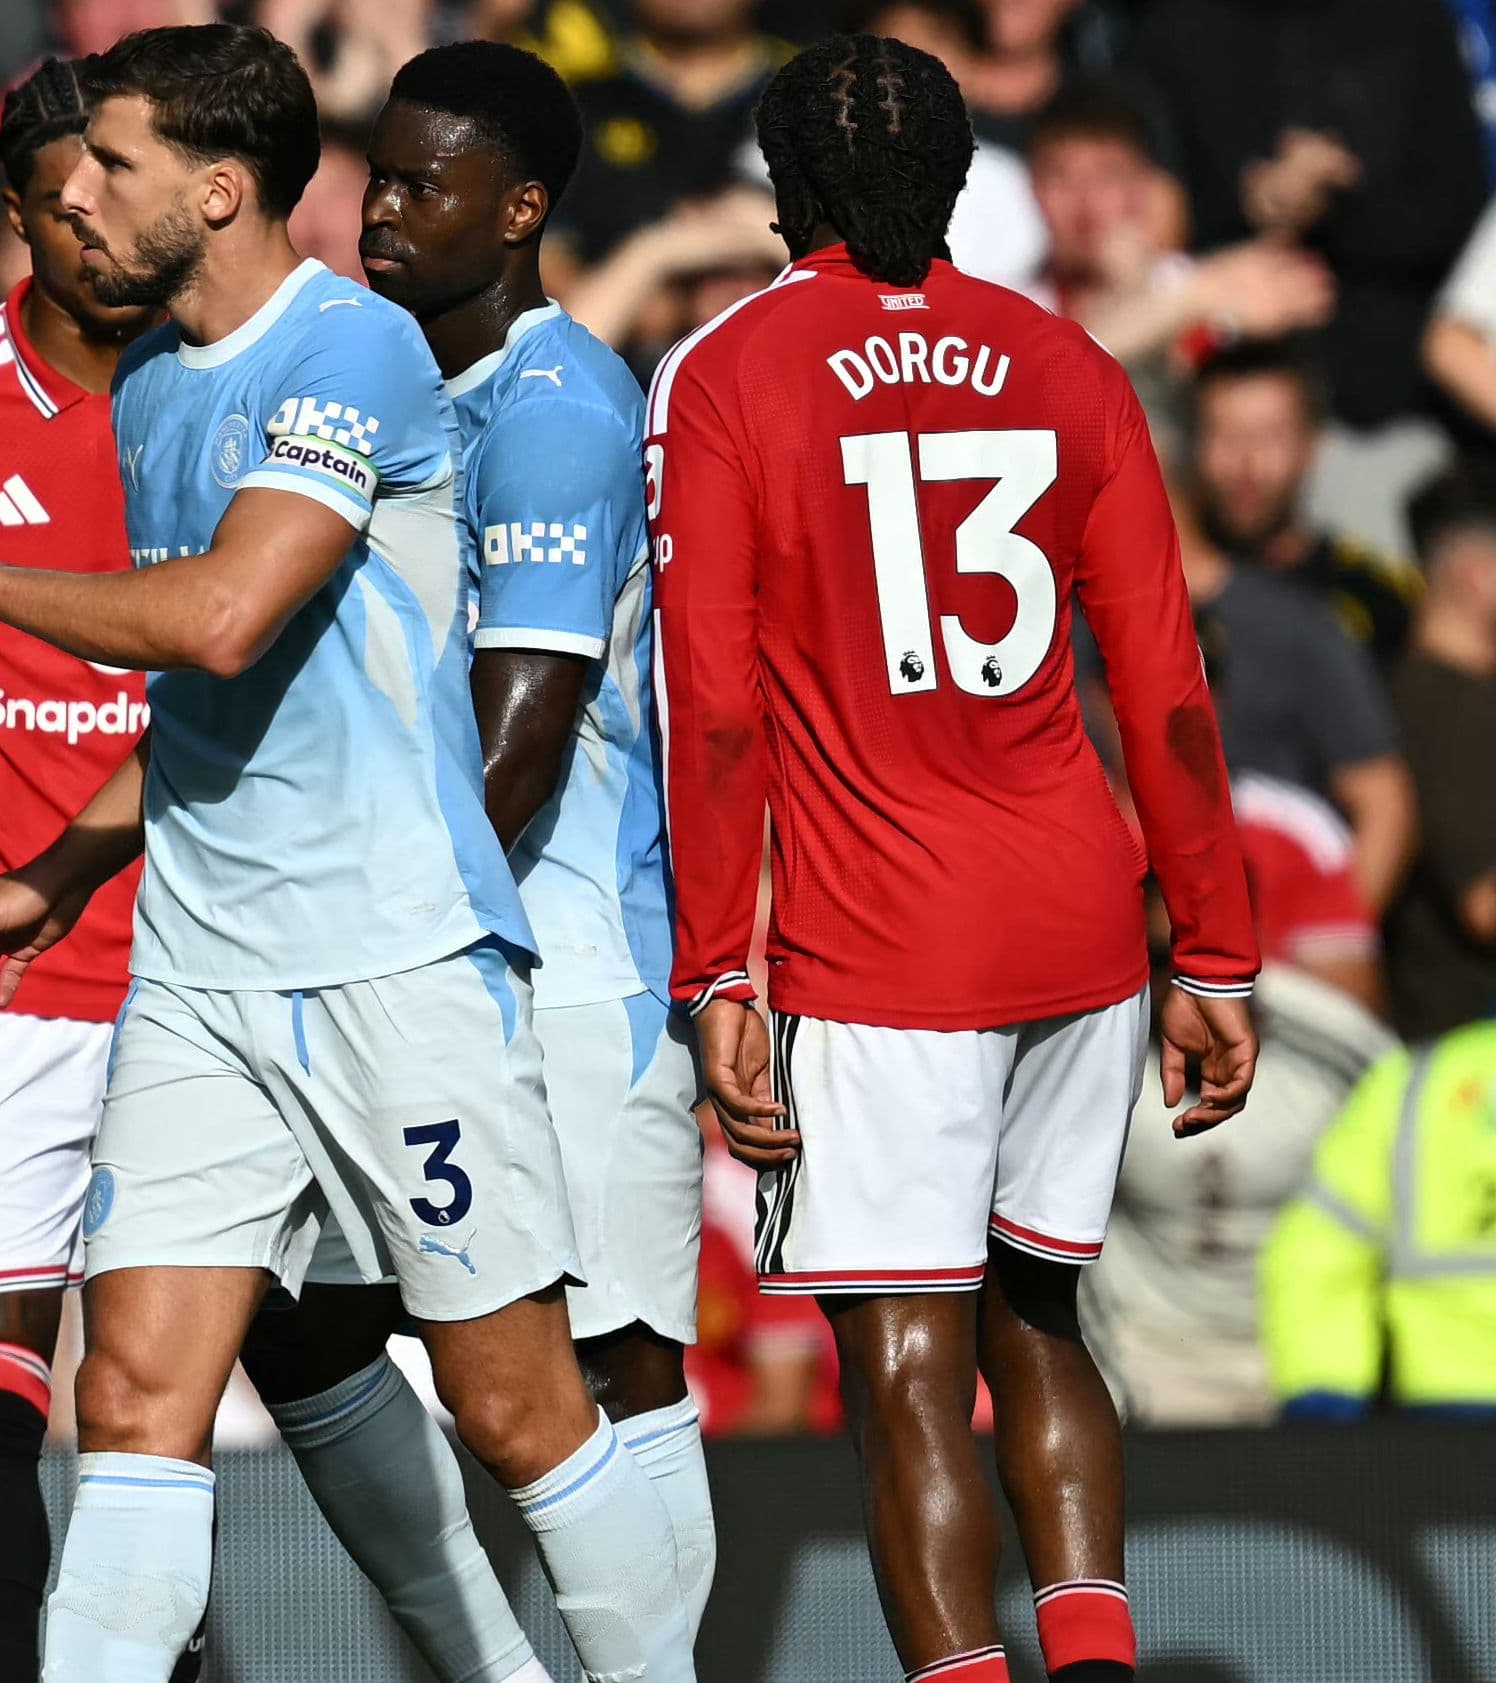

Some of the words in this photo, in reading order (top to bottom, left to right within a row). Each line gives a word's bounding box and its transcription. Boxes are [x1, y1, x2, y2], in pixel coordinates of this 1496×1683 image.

[877, 292, 931, 311] UNITED
[826, 331, 1011, 401] DORGU
[267, 396, 380, 456] OKX
[274, 440, 367, 489] Captain
[484, 522, 587, 566] OKX
[839, 428, 1058, 697] 13
[403, 1118, 473, 1227] 3
